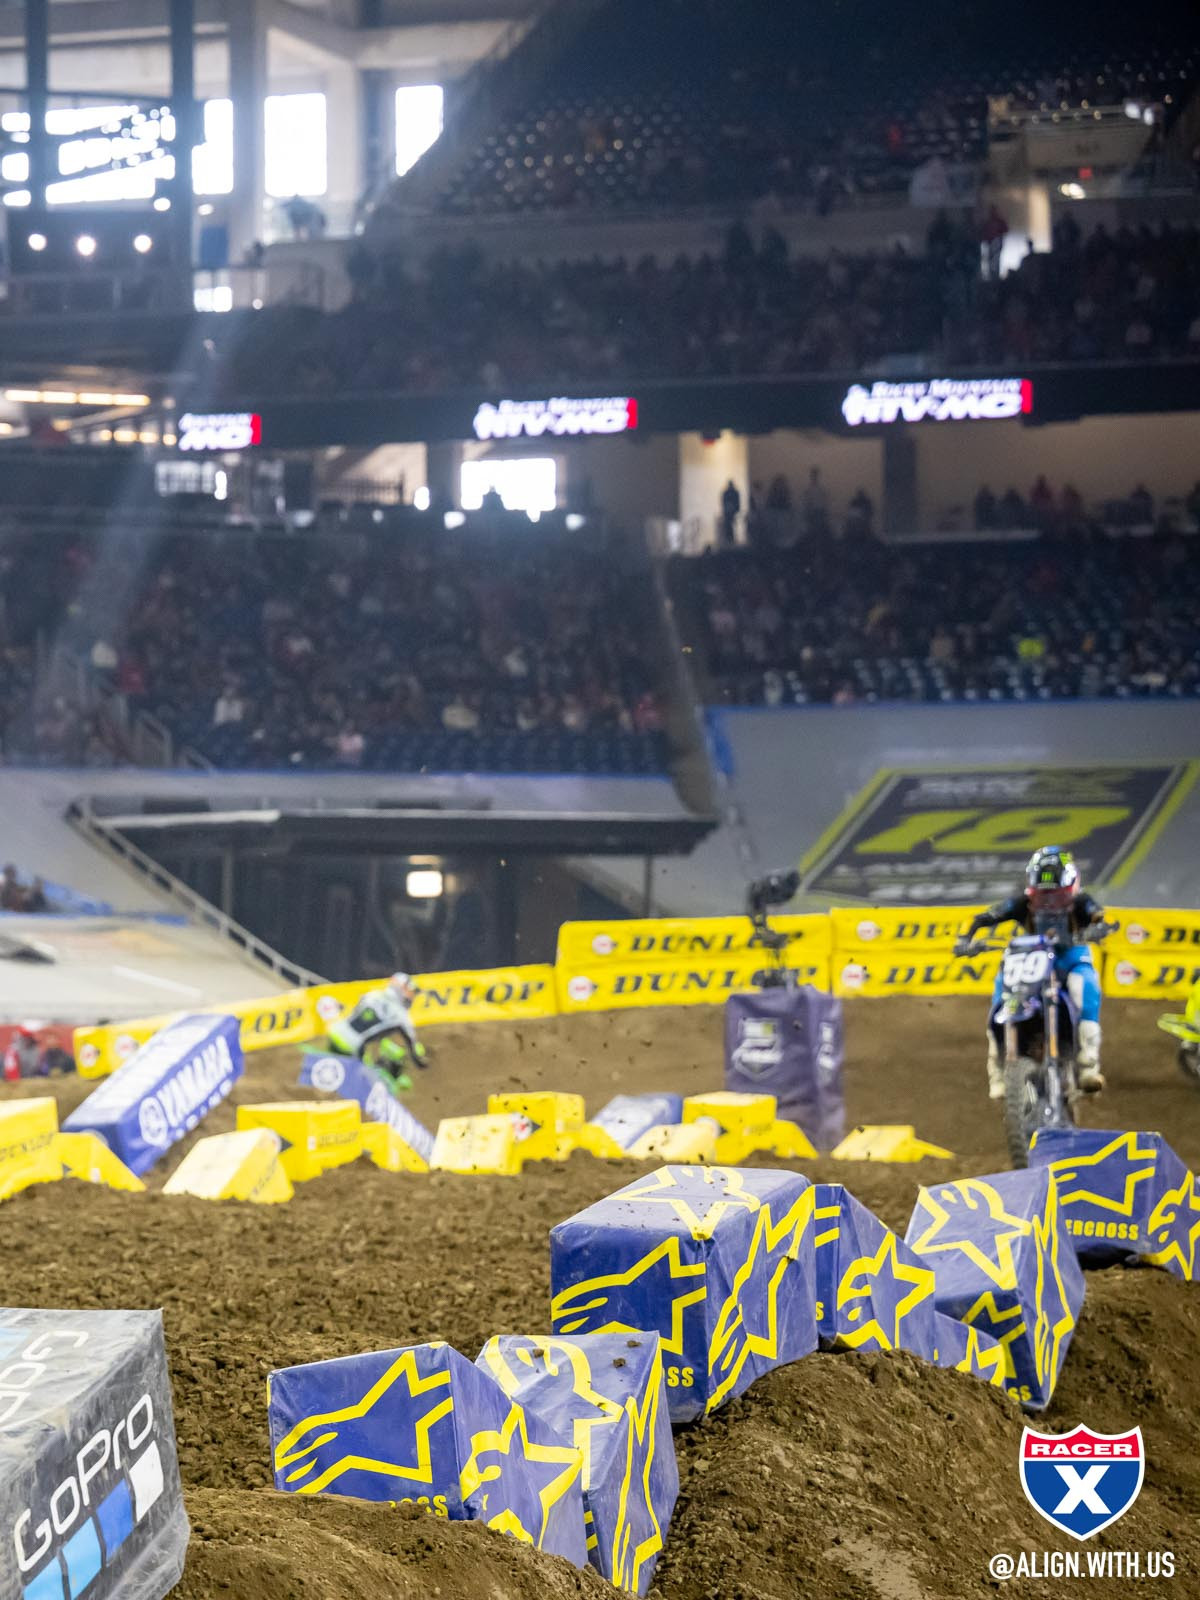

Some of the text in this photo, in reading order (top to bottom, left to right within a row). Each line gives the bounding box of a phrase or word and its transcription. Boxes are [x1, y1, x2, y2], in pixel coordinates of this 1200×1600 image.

[854, 806, 1132, 854] 18
[630, 931, 803, 951] DUNL
[885, 963, 990, 983] DUN
[415, 981, 544, 1008] NLOP
[156, 1035, 234, 1127] YAMAHA
[1065, 1218, 1139, 1241] ERCROSS
[14, 1394, 154, 1572] GoPro
